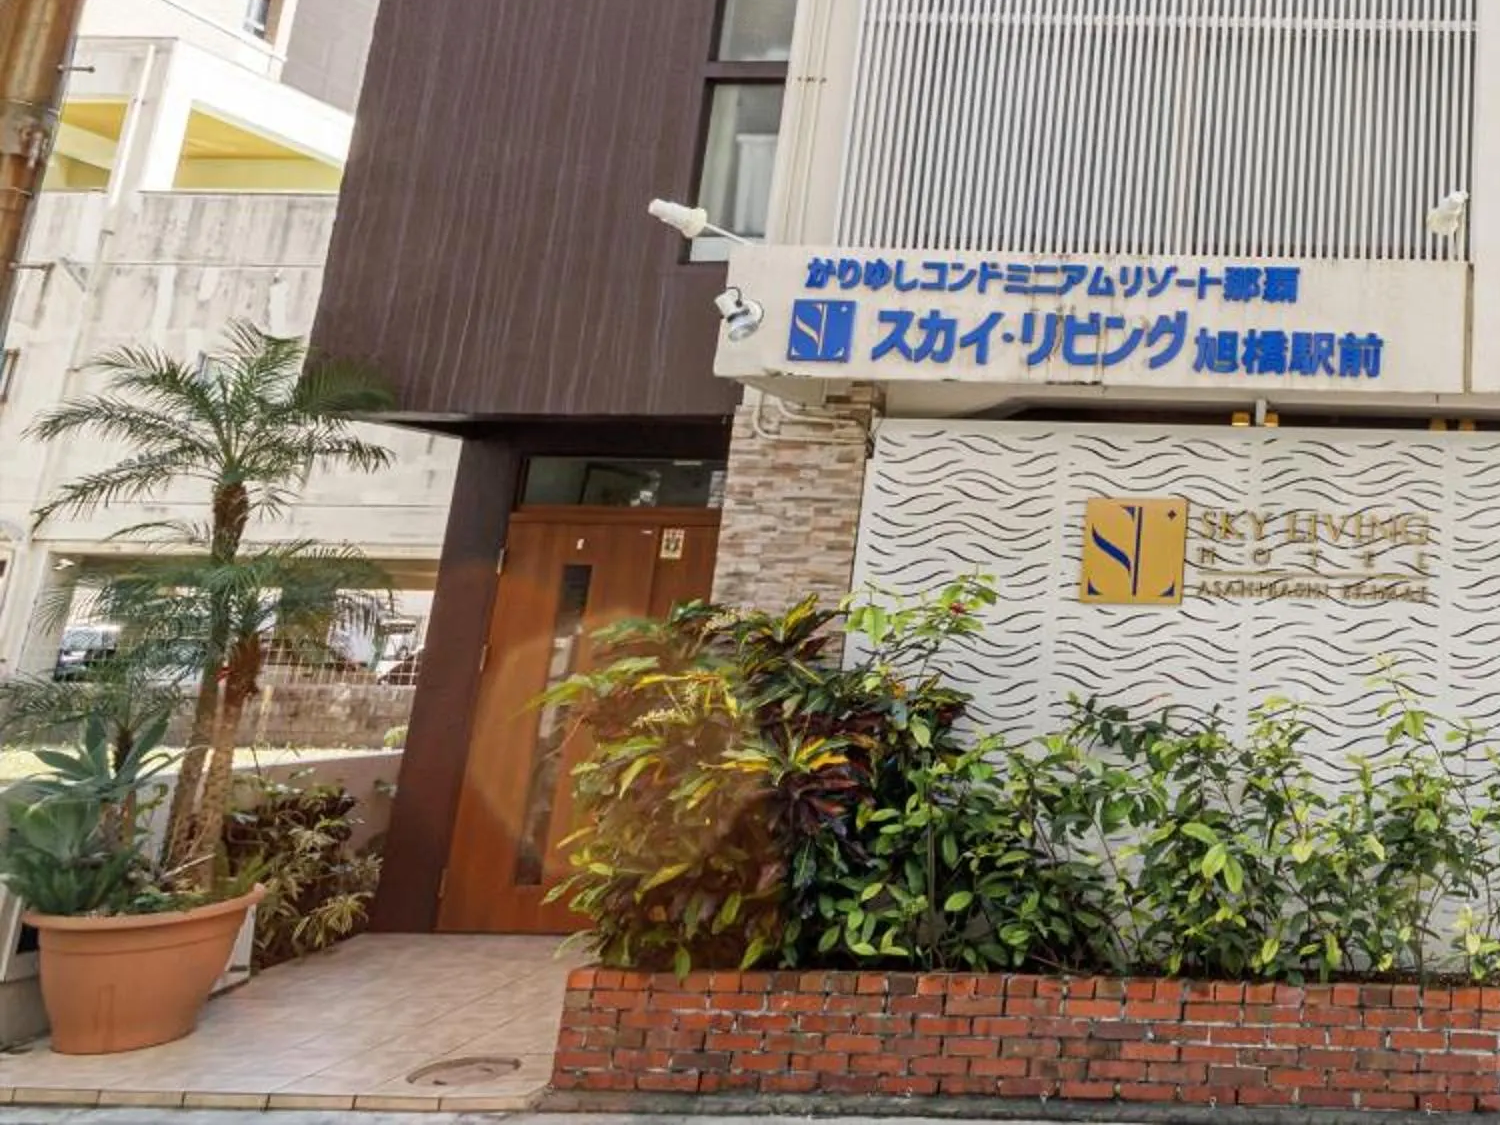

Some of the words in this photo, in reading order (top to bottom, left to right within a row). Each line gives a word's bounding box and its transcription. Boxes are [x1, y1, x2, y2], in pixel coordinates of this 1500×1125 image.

[870, 309, 1188, 366] スカイ・リビング
[1193, 327, 1384, 379] 旭橋駅前
[1201, 510, 1272, 542] SKY
[1284, 512, 1430, 545] LIVING
